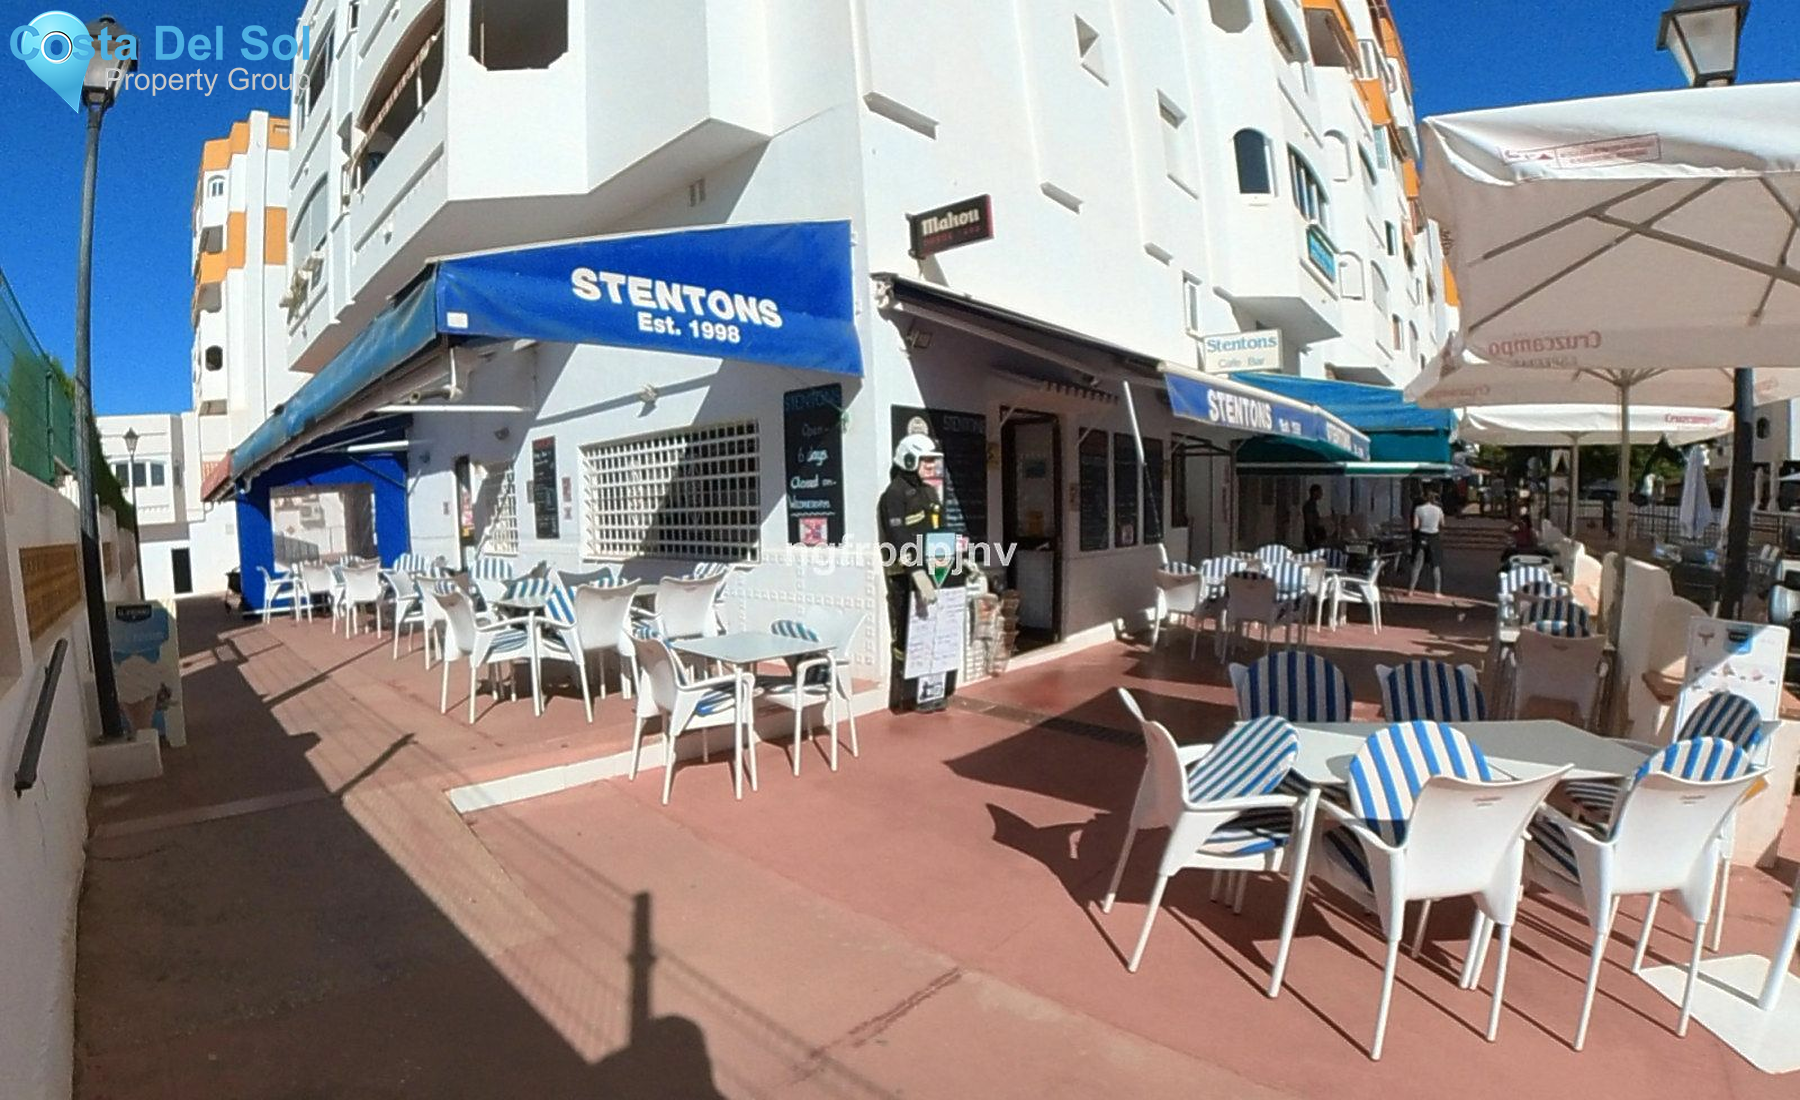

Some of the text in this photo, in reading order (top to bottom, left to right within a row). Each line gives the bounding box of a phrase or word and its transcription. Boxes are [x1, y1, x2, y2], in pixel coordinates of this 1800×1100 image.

[571, 267, 783, 328] STENTONS
[637, 311, 741, 344] Est. 1998
[1206, 335, 1278, 353] Stentons
[1206, 388, 1273, 430] STENTONS
